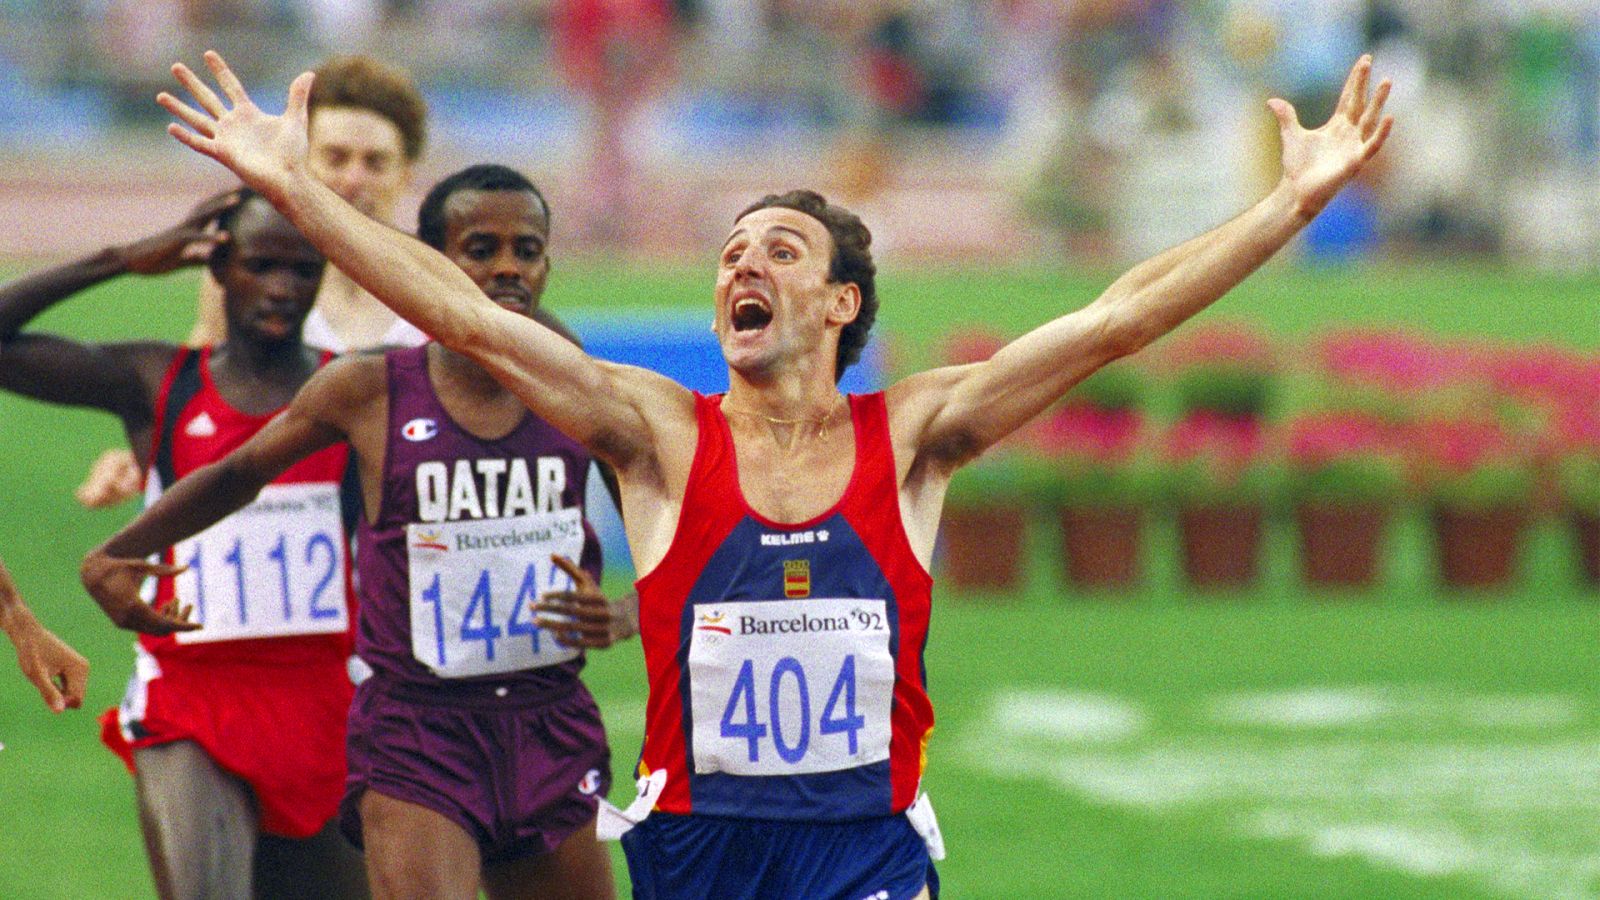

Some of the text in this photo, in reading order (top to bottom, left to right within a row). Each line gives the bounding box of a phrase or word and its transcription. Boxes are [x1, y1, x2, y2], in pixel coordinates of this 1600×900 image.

[416, 456, 567, 522] QATAR
[456, 529, 552, 551] Barcelona
[761, 530, 815, 546] KELME
[188, 532, 340, 625] 1112
[739, 608, 884, 636] Barcelona '92
[720, 654, 866, 765] 404
